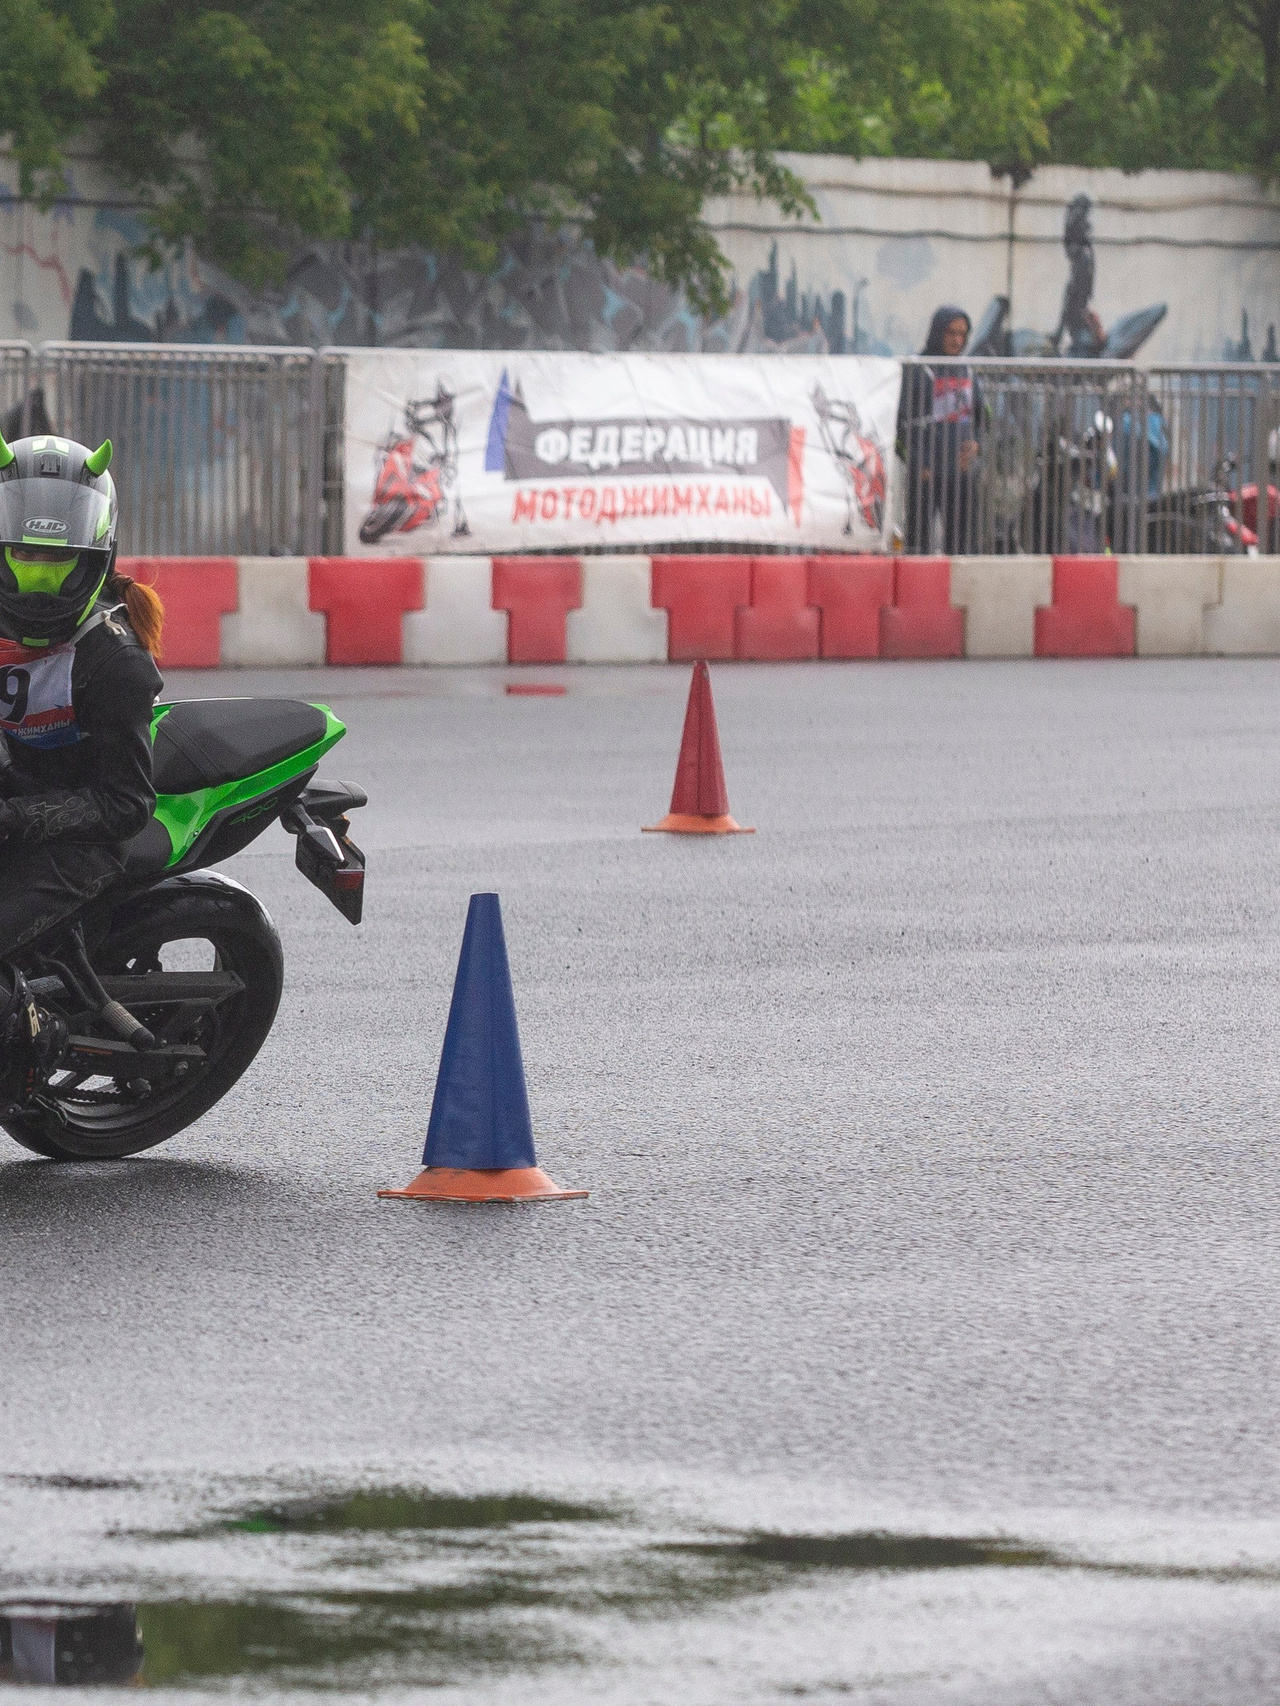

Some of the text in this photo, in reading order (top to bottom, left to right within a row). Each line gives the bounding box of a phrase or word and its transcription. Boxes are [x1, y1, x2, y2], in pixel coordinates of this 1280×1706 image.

[535, 427, 758, 468] ФЕДЕРАЦИЯ
[513, 486, 772, 523] МОТОДЖИМХАНЫ
[28, 520, 64, 531] HJC
